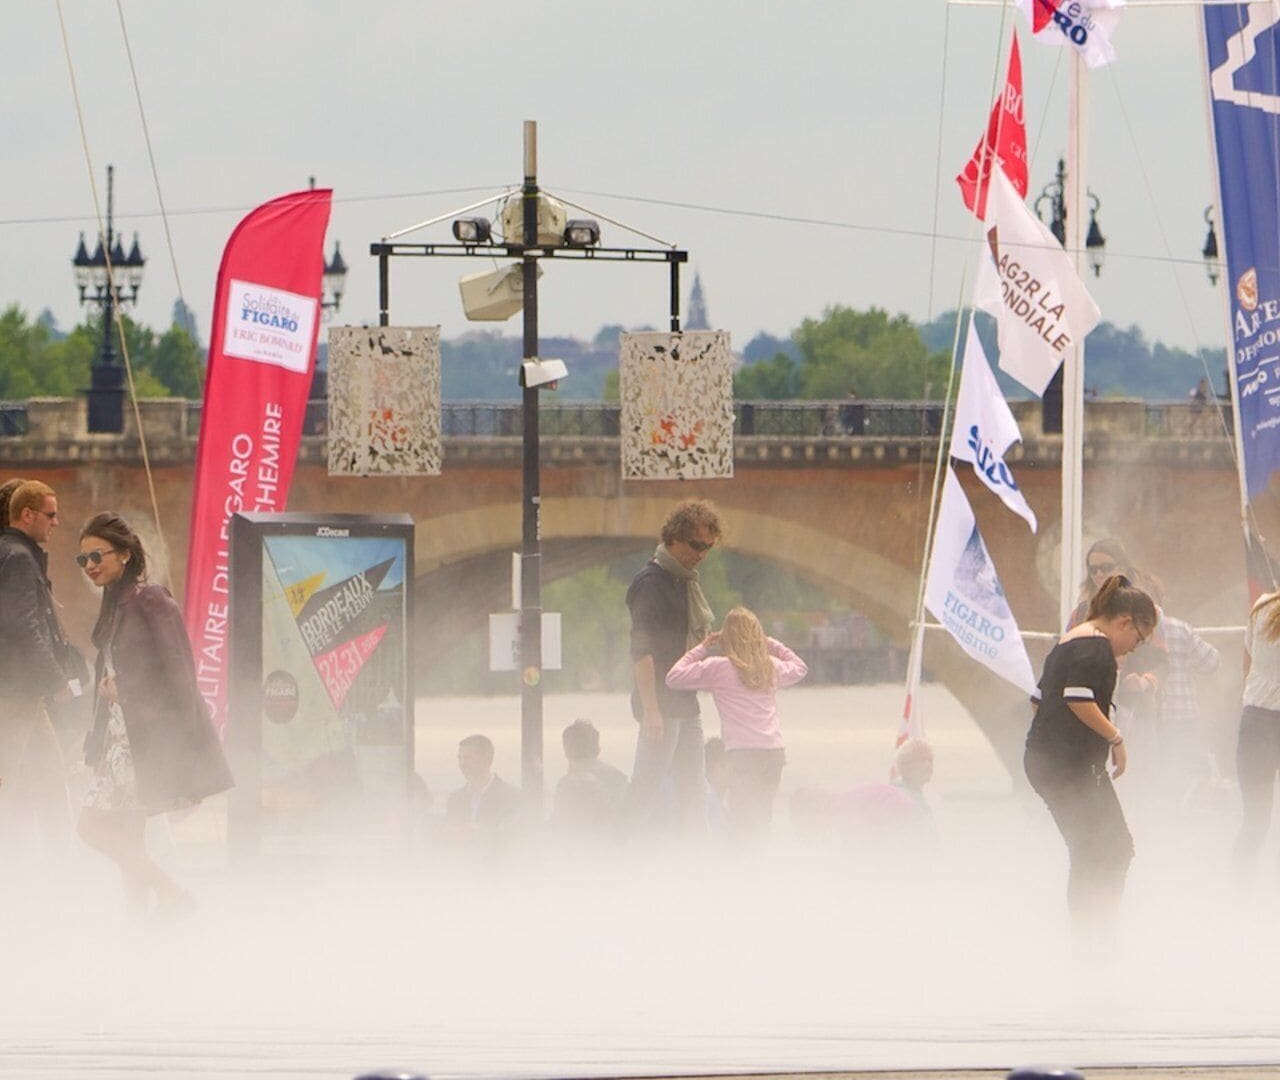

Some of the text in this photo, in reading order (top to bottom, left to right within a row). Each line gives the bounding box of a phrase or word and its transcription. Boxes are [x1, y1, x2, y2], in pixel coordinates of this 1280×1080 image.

[999, 253, 1065, 322] AG2R LA
[241, 308, 298, 333] FIGARO
[301, 571, 374, 644] BORDEAUX
[943, 591, 1006, 644] FIGARO
